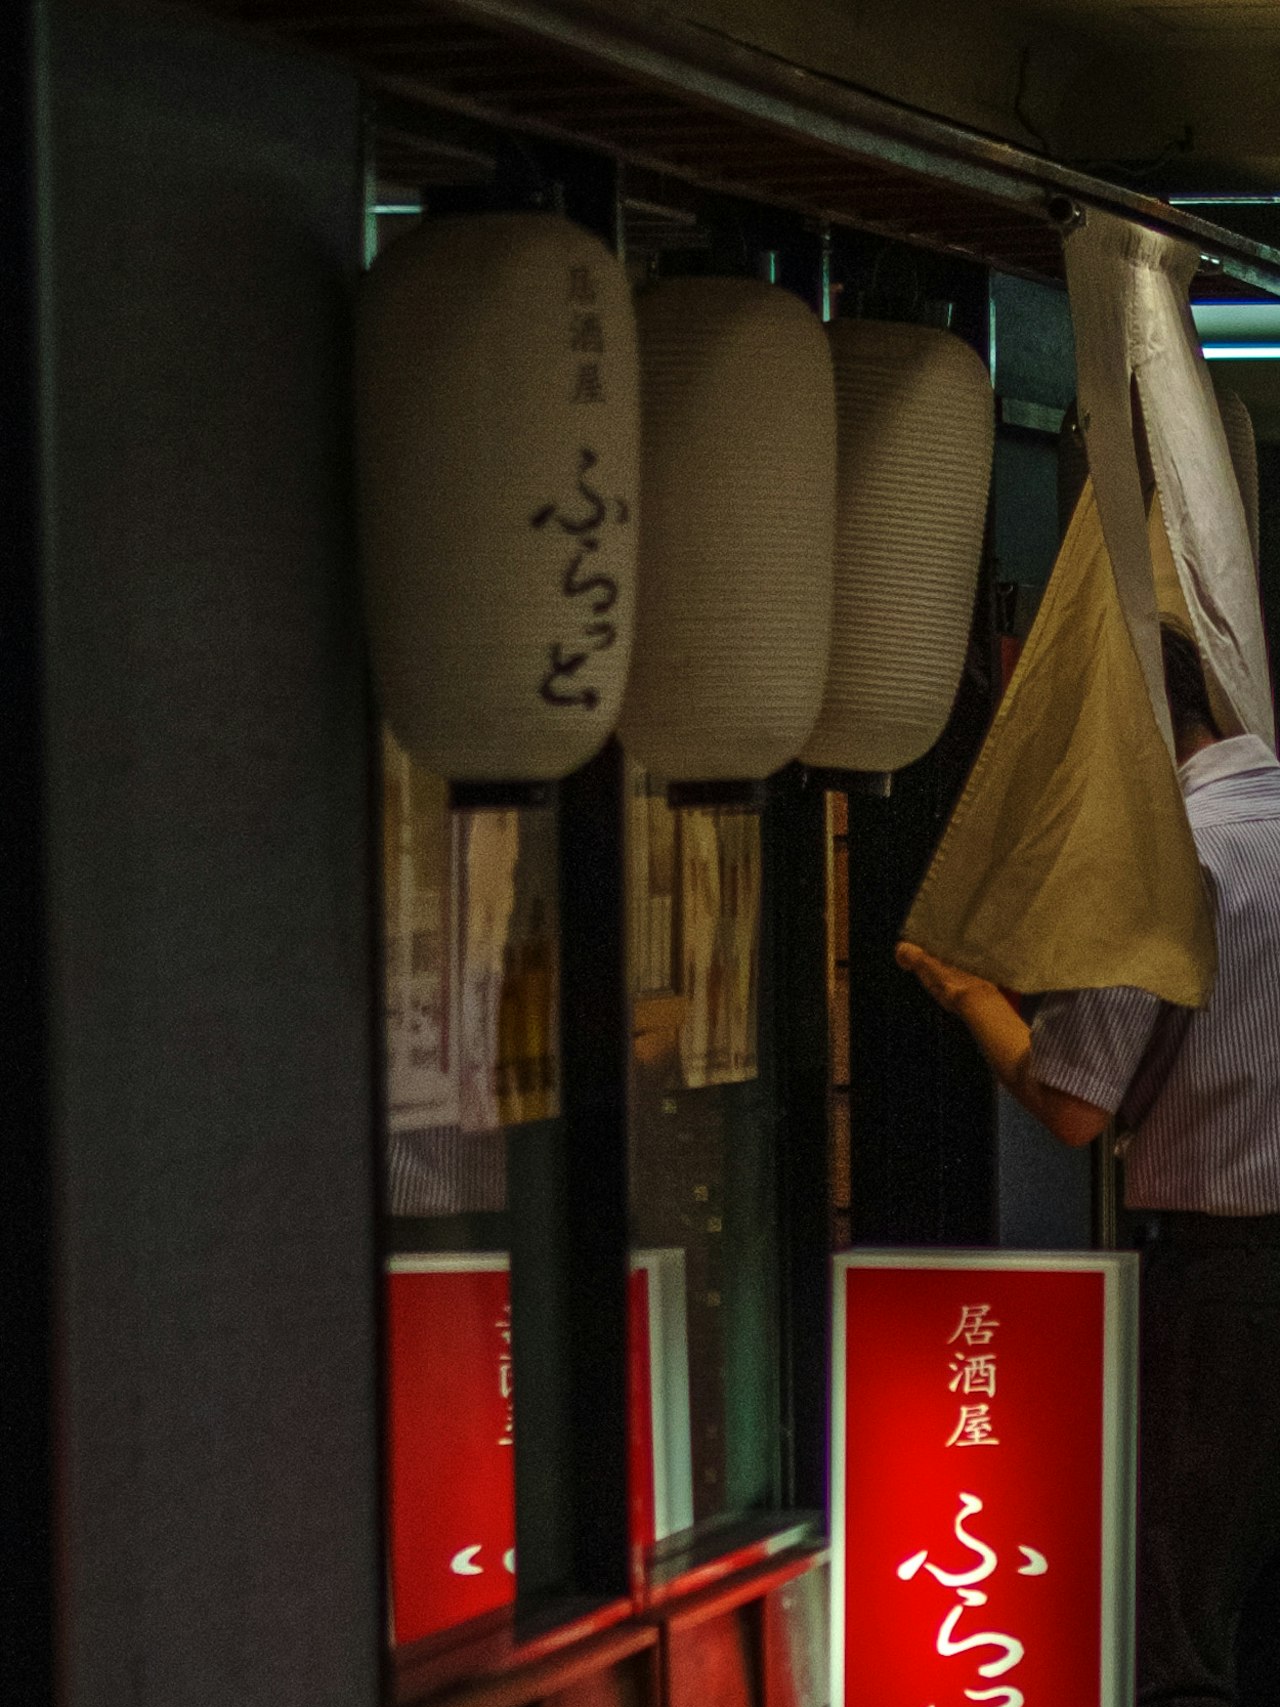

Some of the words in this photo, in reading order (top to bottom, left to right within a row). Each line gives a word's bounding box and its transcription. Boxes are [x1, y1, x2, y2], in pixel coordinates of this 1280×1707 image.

[533, 448, 628, 710] ふらっと
[945, 1304, 999, 1448] 居酒屋
